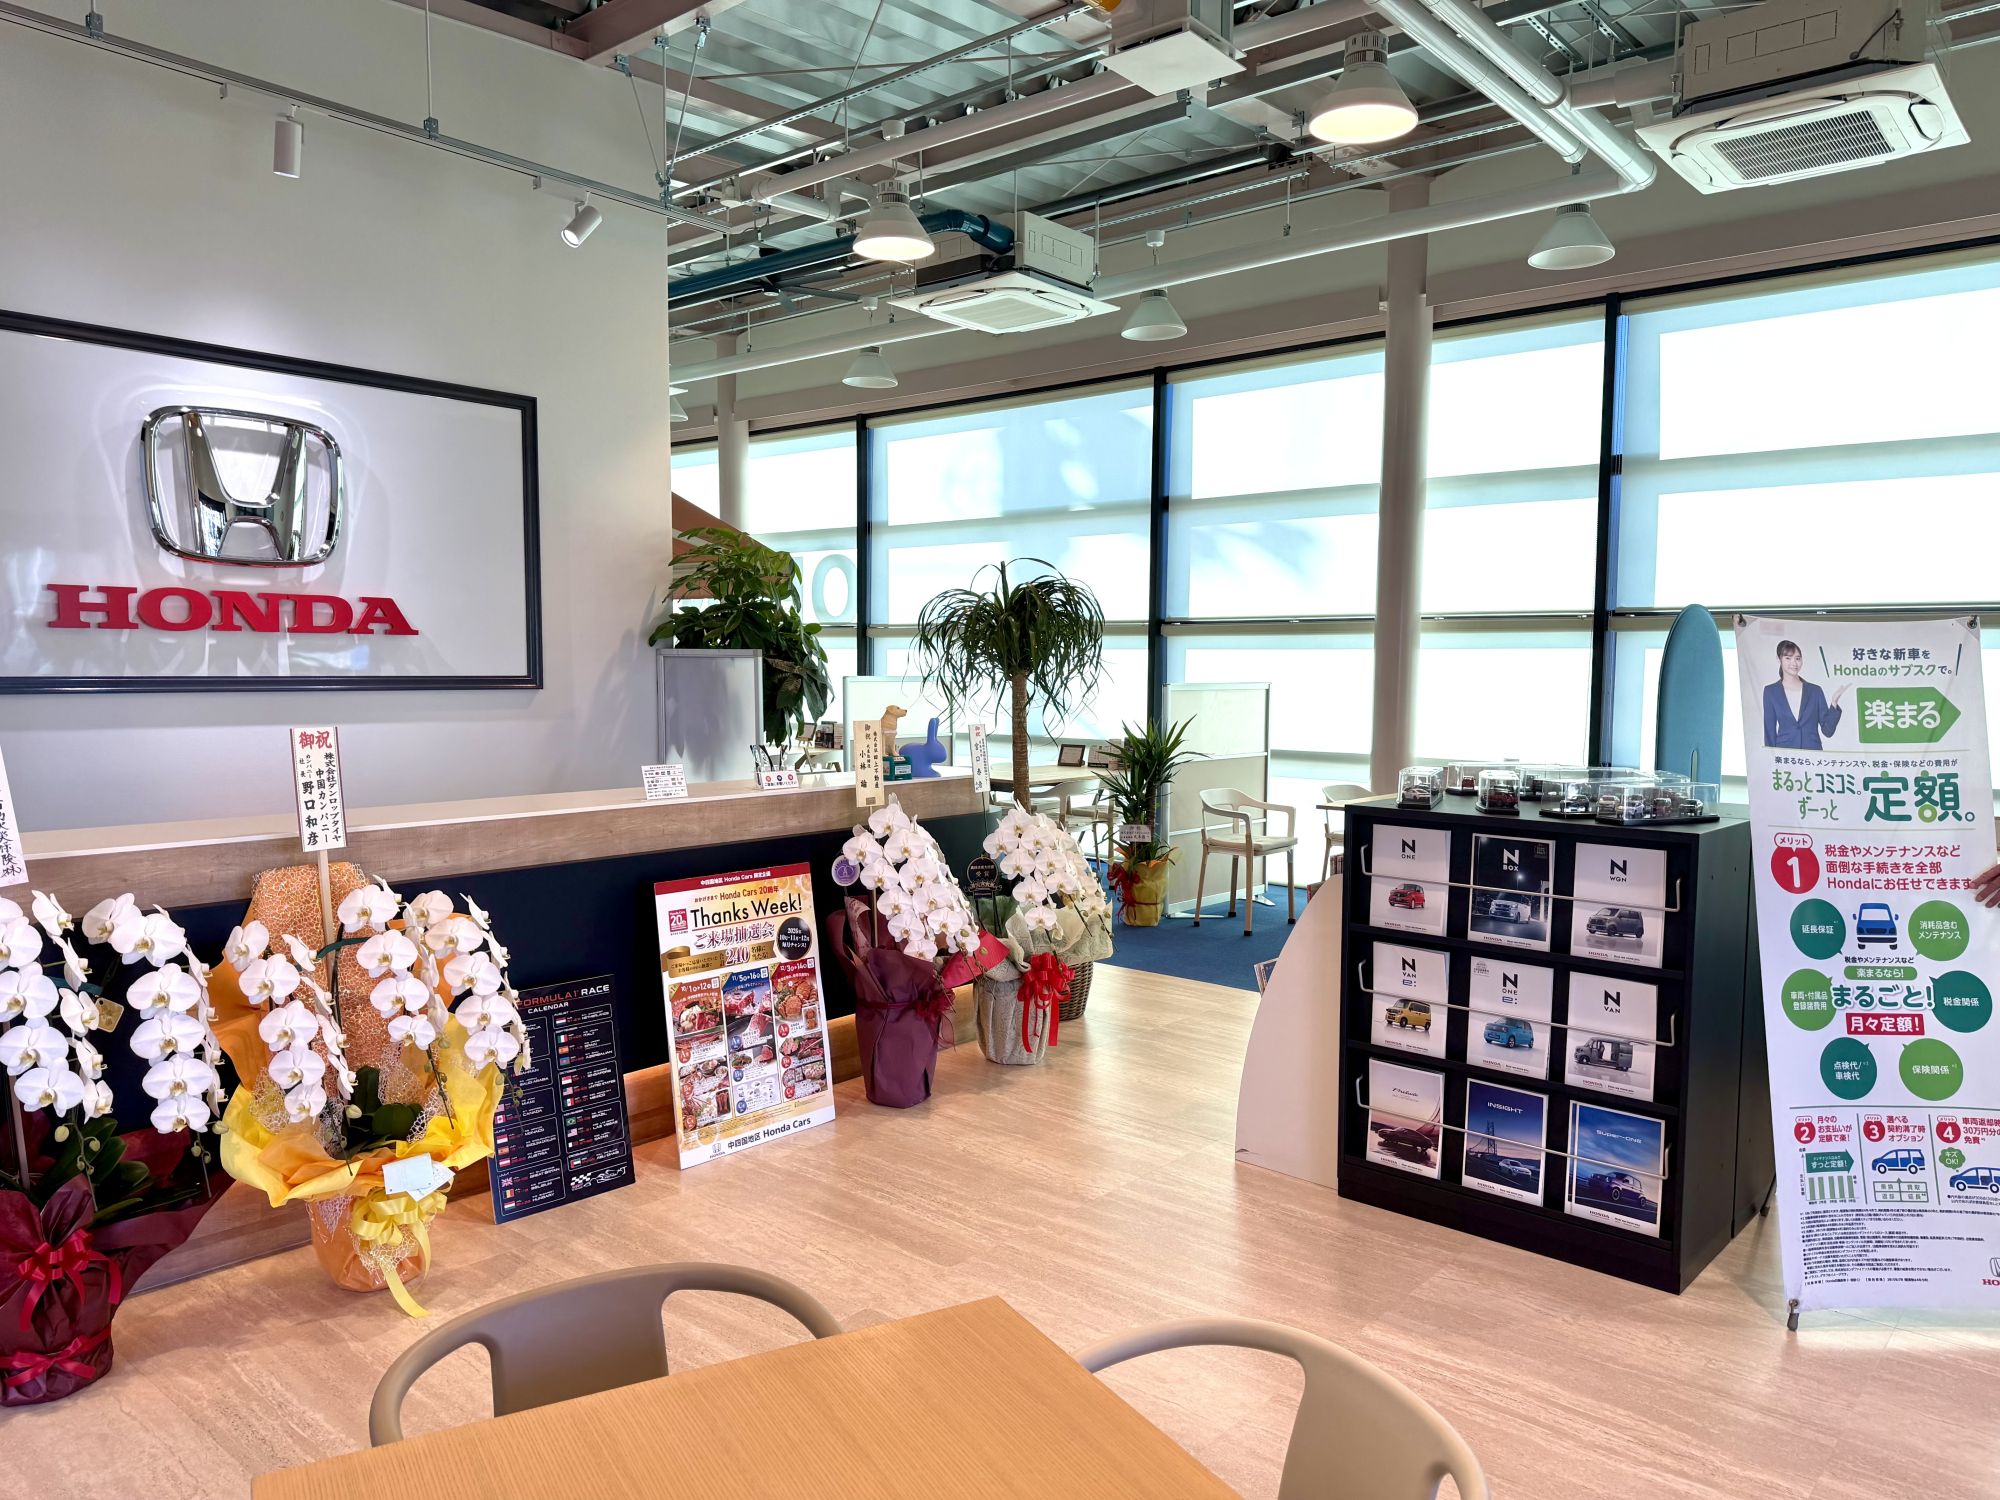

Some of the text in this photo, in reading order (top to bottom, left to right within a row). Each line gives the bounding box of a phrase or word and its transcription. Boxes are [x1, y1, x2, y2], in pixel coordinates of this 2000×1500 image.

[46, 583, 419, 635] HONDA
[1852, 647, 1931, 661] 好きな新車を
[1833, 663, 1953, 677] Hondaのサブスクで。
[1864, 699, 1941, 729] 楽まる
[299, 730, 332, 750] 御祝
[1774, 755, 1958, 769] 楽まるなら、メンテナンスや、税金・保険などの費用が
[1771, 769, 1862, 796] まるっとコミコミ。
[324, 752, 341, 842] 株式会社ダンロップタイヤ
[1862, 769, 1976, 823] 定額。
[315, 768, 330, 843] 中国カンパニー
[1797, 795, 1840, 821] ずーっと
[301, 781, 319, 846] 野口和彦
[1401, 838, 1416, 854] N
[1779, 837, 1809, 846] メリット
[1503, 848, 1520, 865] N
[1824, 844, 1962, 858] 税金やメンテナンスなど
[1503, 864, 1519, 872] BOX
[1610, 858, 1627, 876] N
[1786, 855, 1801, 888] 1
[1825, 860, 1943, 875] 面倒な手続きを全部
[723, 875, 741, 883] Honda
[741, 872, 753, 881] Cars
[1610, 875, 1627, 883] WGN
[1827, 877, 1972, 891] Hondaにお任せできます
[719, 890, 741, 901] Honda
[742, 888, 758, 898] Cars
[690, 892, 802, 928] Thanks Week!
[1801, 924, 1835, 935] 延長保証
[1919, 920, 1958, 931] 消耗品含む
[694, 922, 775, 949] ご来場抽選会
[1918, 931, 1962, 941] メンテナンス
[1401, 956, 1417, 973] N
[1844, 955, 1915, 964] 税金やメンテナンスなど
[1503, 971, 1518, 989] N
[1856, 967, 1905, 979] 楽まるなら!
[581, 984, 610, 996] RACE
[1502, 988, 1518, 996] ONE
[1790, 991, 1829, 1001] 車両・付属品
[1832, 984, 1934, 1009] まるごと!
[1604, 989, 1621, 1008] N
[1943, 996, 1980, 1007] 税金関係
[528, 1002, 569, 1014] CALENDAR
[1604, 1006, 1621, 1014] VAN
[1792, 1001, 1828, 1011] 登録諸費用
[1850, 1016, 1920, 1033] 月々定額!
[1833, 1060, 1862, 1070] 点検代/
[1911, 1065, 1950, 1075] 保険関係
[1835, 1071, 1860, 1081] 車検代
[1487, 1101, 1524, 1114] INSIGHT
[1817, 1115, 1838, 1124] 月々の
[1886, 1115, 1909, 1124] 選べる
[762, 1123, 792, 1139] Honda
[792, 1116, 812, 1129] Cars
[1800, 1126, 1811, 1141] 2
[1818, 1124, 1853, 1133] お支払いが
[1869, 1124, 1880, 1140] 3
[1887, 1125, 1926, 1133] 契約満了時
[1943, 1125, 1955, 1141] 4
[1888, 1134, 1924, 1143] オプション
[1964, 1136, 1981, 1145] 免責
